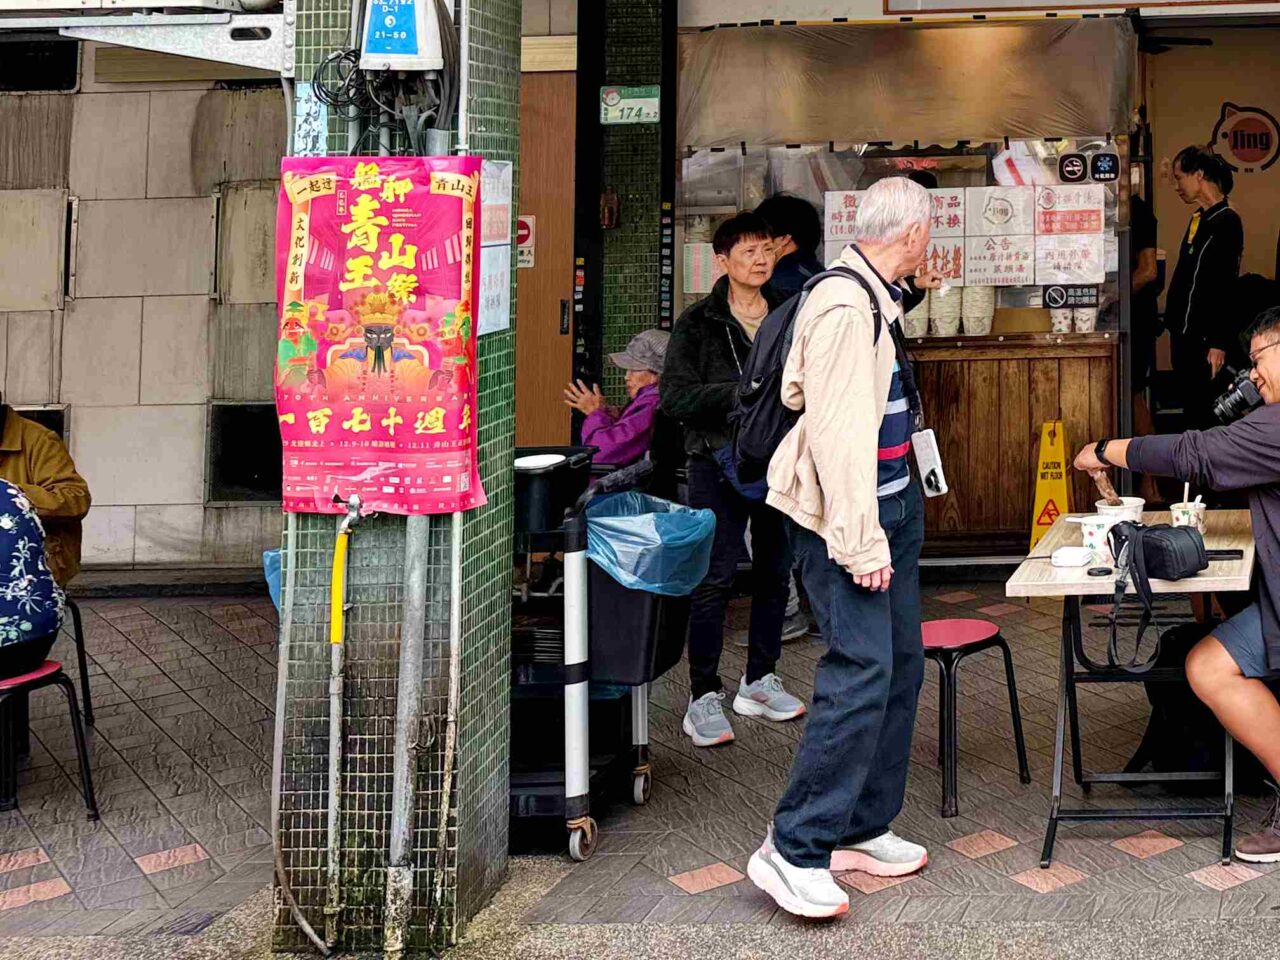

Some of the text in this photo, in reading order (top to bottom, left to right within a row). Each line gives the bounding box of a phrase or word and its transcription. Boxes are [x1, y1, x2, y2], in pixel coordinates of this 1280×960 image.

[375, 31, 407, 39] 21-50
[619, 107, 643, 120] 174
[1231, 130, 1271, 151] Jing
[984, 238, 1012, 251] 公告
[1042, 461, 1062, 470] CAUTION
